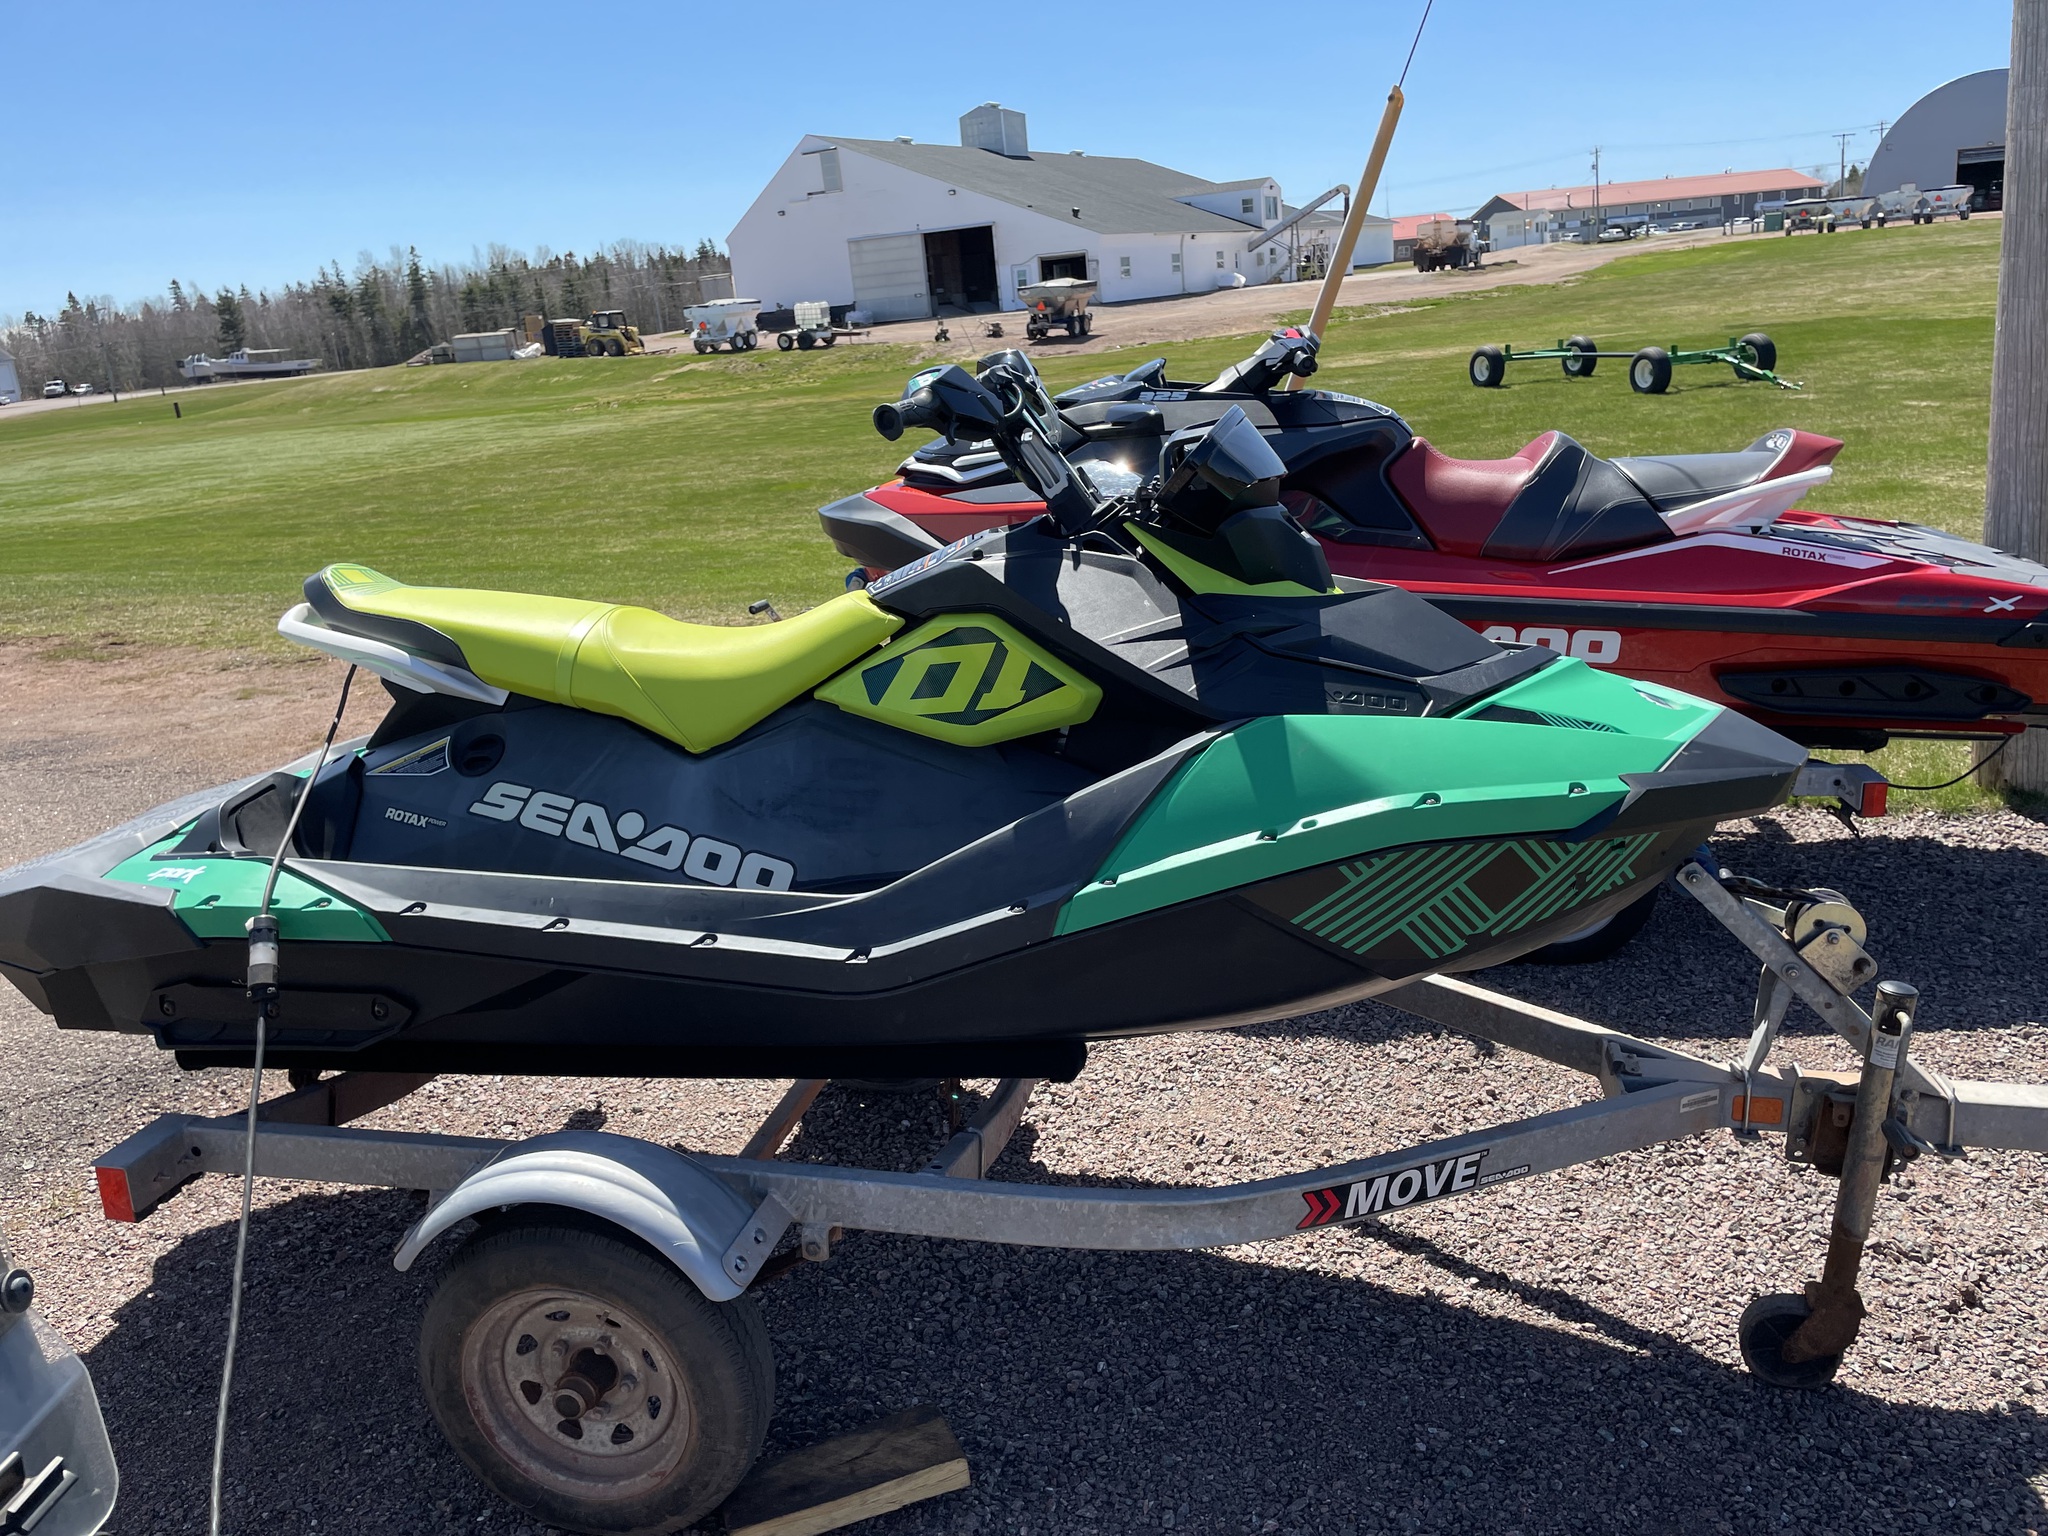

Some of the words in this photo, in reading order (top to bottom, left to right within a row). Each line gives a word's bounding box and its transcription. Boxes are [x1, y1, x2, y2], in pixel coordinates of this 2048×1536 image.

[1782, 546, 1827, 561] ROTAX
[385, 807, 429, 828] ROTAX
[1344, 1152, 1481, 1219] MOVE
